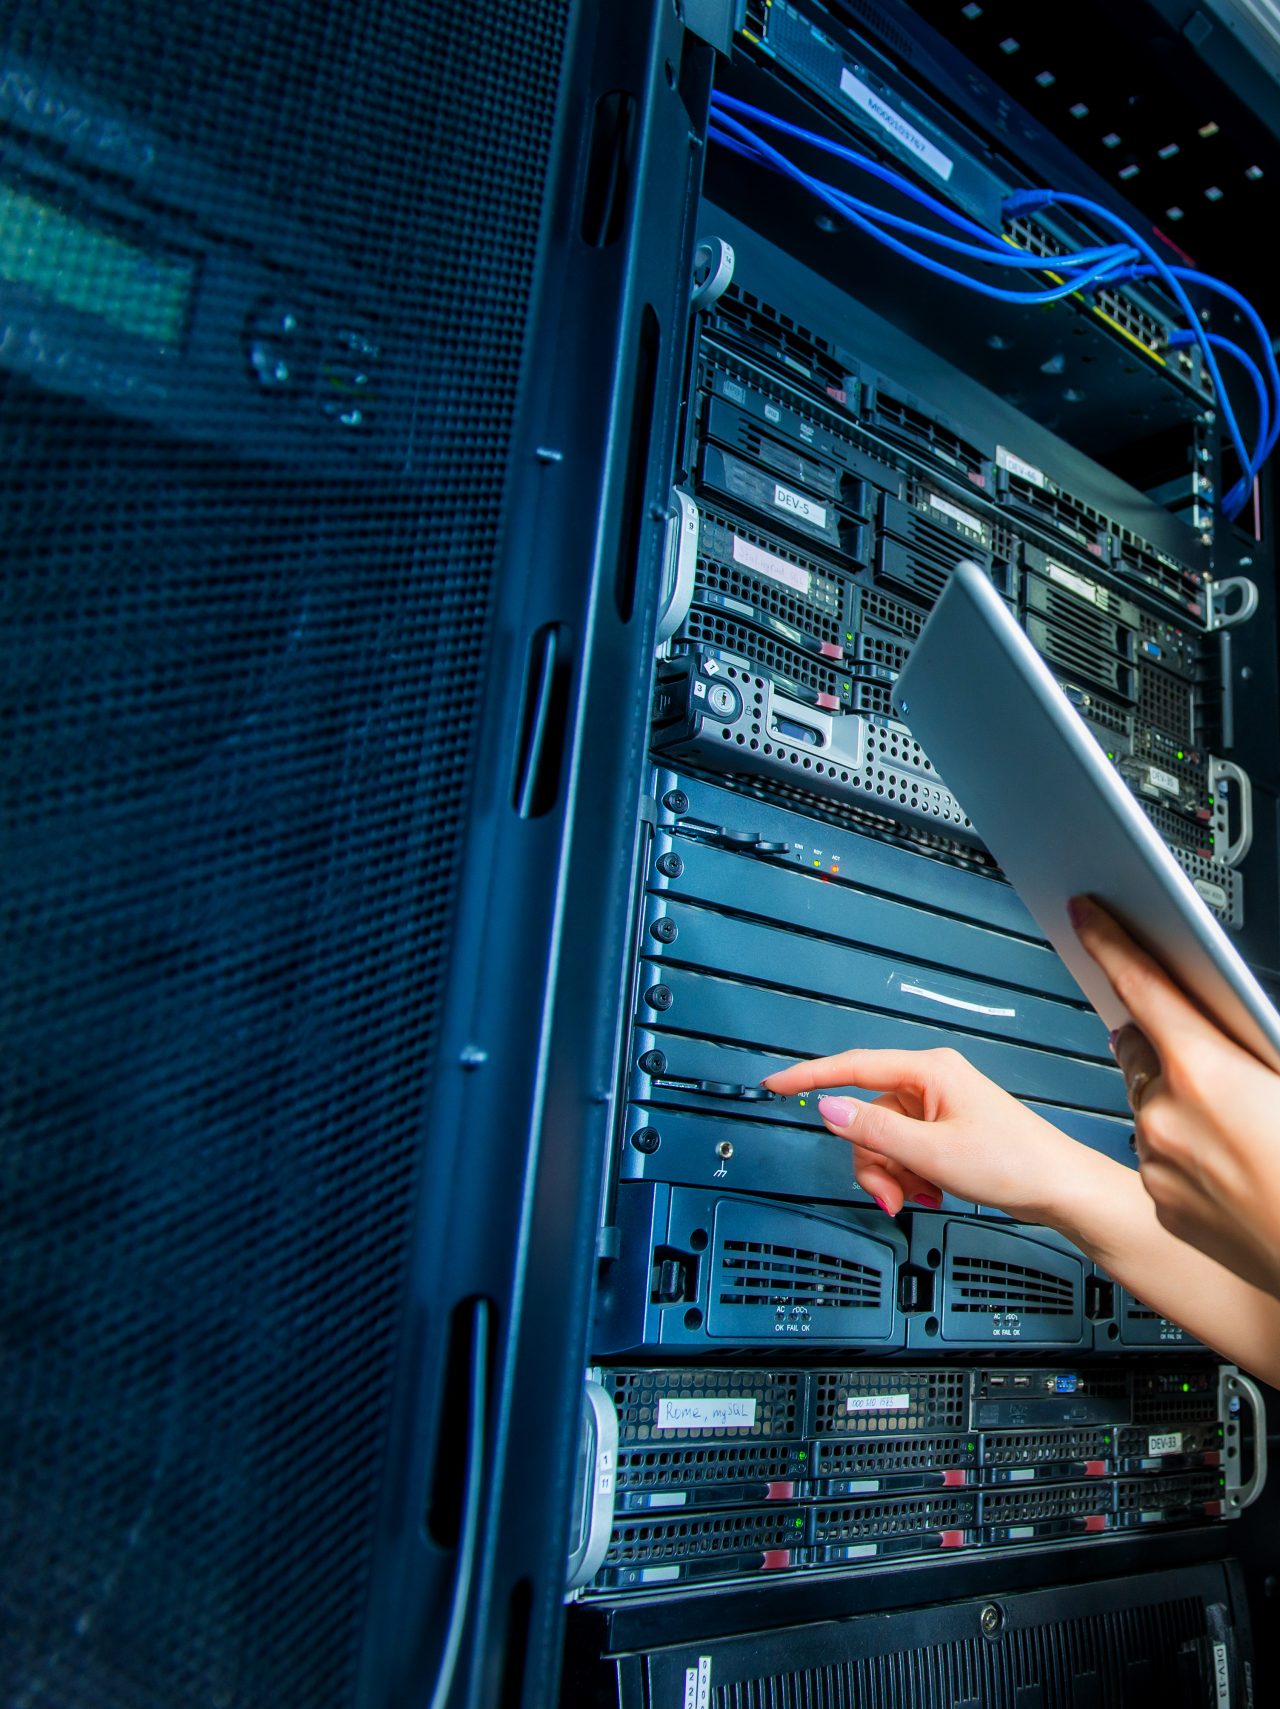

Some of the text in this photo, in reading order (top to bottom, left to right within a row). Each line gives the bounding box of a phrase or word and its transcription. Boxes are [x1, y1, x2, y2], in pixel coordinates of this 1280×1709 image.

[777, 490, 810, 515] DEV-5
[689, 522, 694, 530] 9
[697, 684, 703, 692] 3
[1151, 1436, 1176, 1450] DEV-33
[602, 1478, 609, 1489] 11
[637, 1495, 643, 1505] 4
[629, 1572, 635, 1583] 0
[1216, 1648, 1227, 1698] DEV-13
